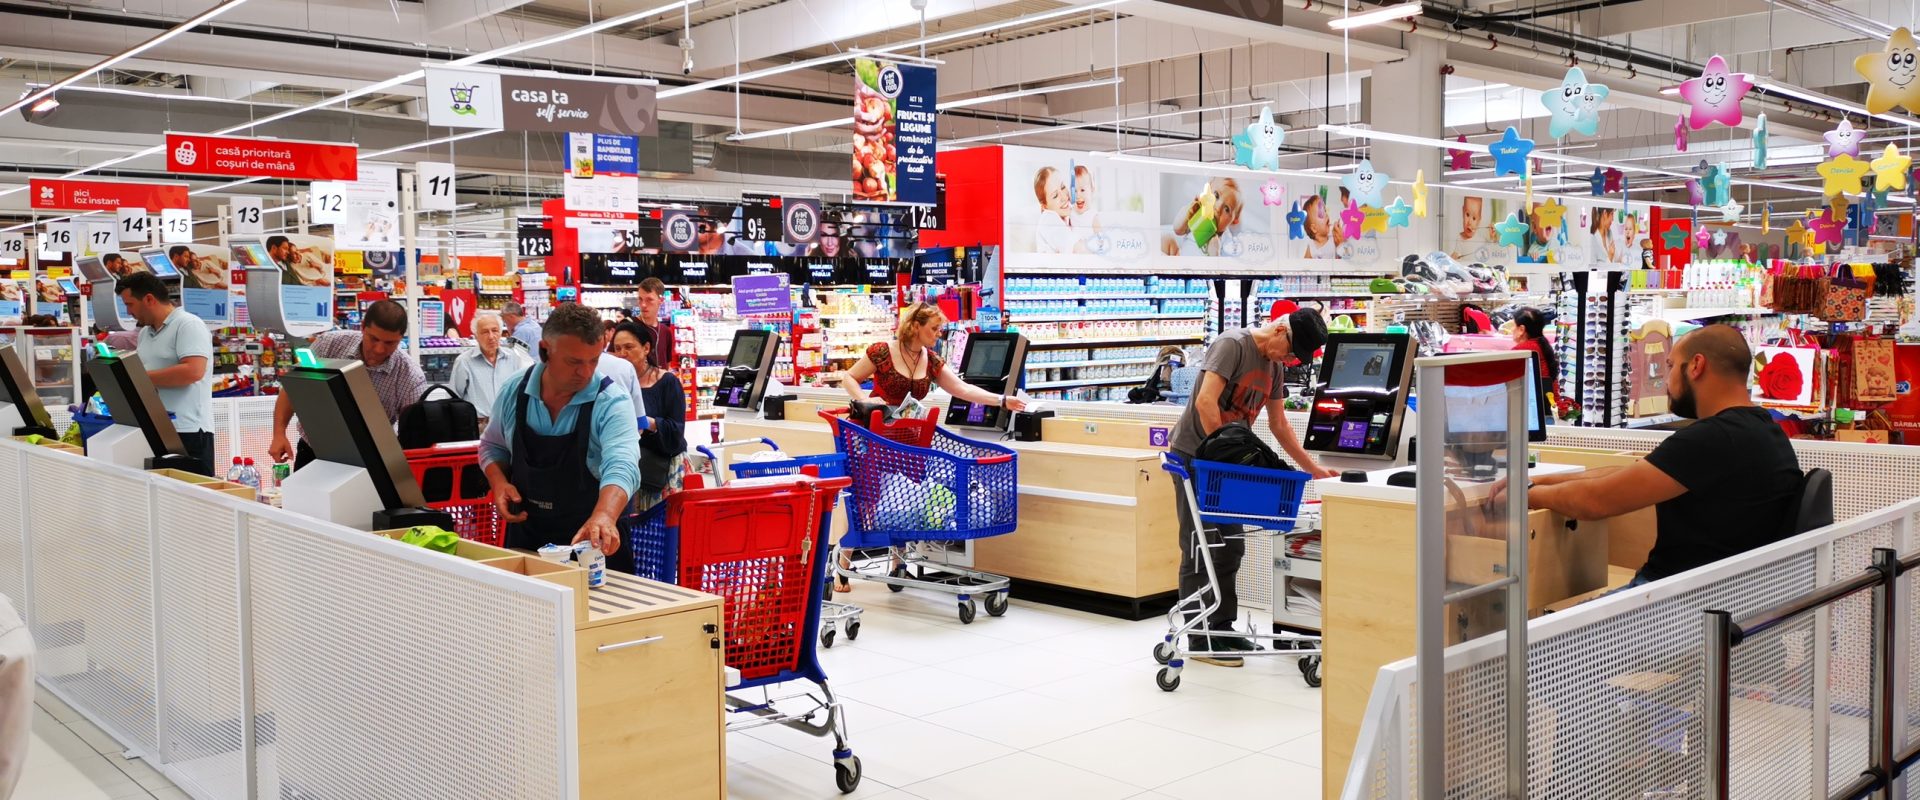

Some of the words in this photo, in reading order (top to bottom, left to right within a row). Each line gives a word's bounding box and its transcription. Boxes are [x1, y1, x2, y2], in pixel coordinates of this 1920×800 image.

[511, 89, 547, 103] casa
[552, 90, 568, 104] ta
[536, 104, 556, 122] self
[557, 109, 589, 118] service
[897, 110, 926, 121] FRUCTE
[900, 122, 931, 134] LEGUME
[215, 146, 240, 156] casă
[242, 148, 291, 159] prioritară
[907, 145, 916, 154] de
[916, 146, 924, 154] la
[250, 160, 264, 169] de
[266, 162, 295, 171] mână
[429, 175, 450, 196] 11
[73, 189, 90, 197] aici
[88, 197, 120, 205] instant
[319, 194, 343, 211] 12
[238, 207, 260, 223] 13
[910, 205, 927, 228] 12
[927, 215, 937, 228] 00
[122, 217, 144, 232] 14
[168, 218, 188, 233] 15
[747, 218, 757, 239] 9
[757, 227, 766, 239] 75
[796, 218, 807, 226] FOR
[51, 230, 71, 243] 16
[92, 231, 111, 244] 17
[3, 240, 22, 251] 18
[521, 237, 537, 255] 12
[233, 273, 243, 281] 11
